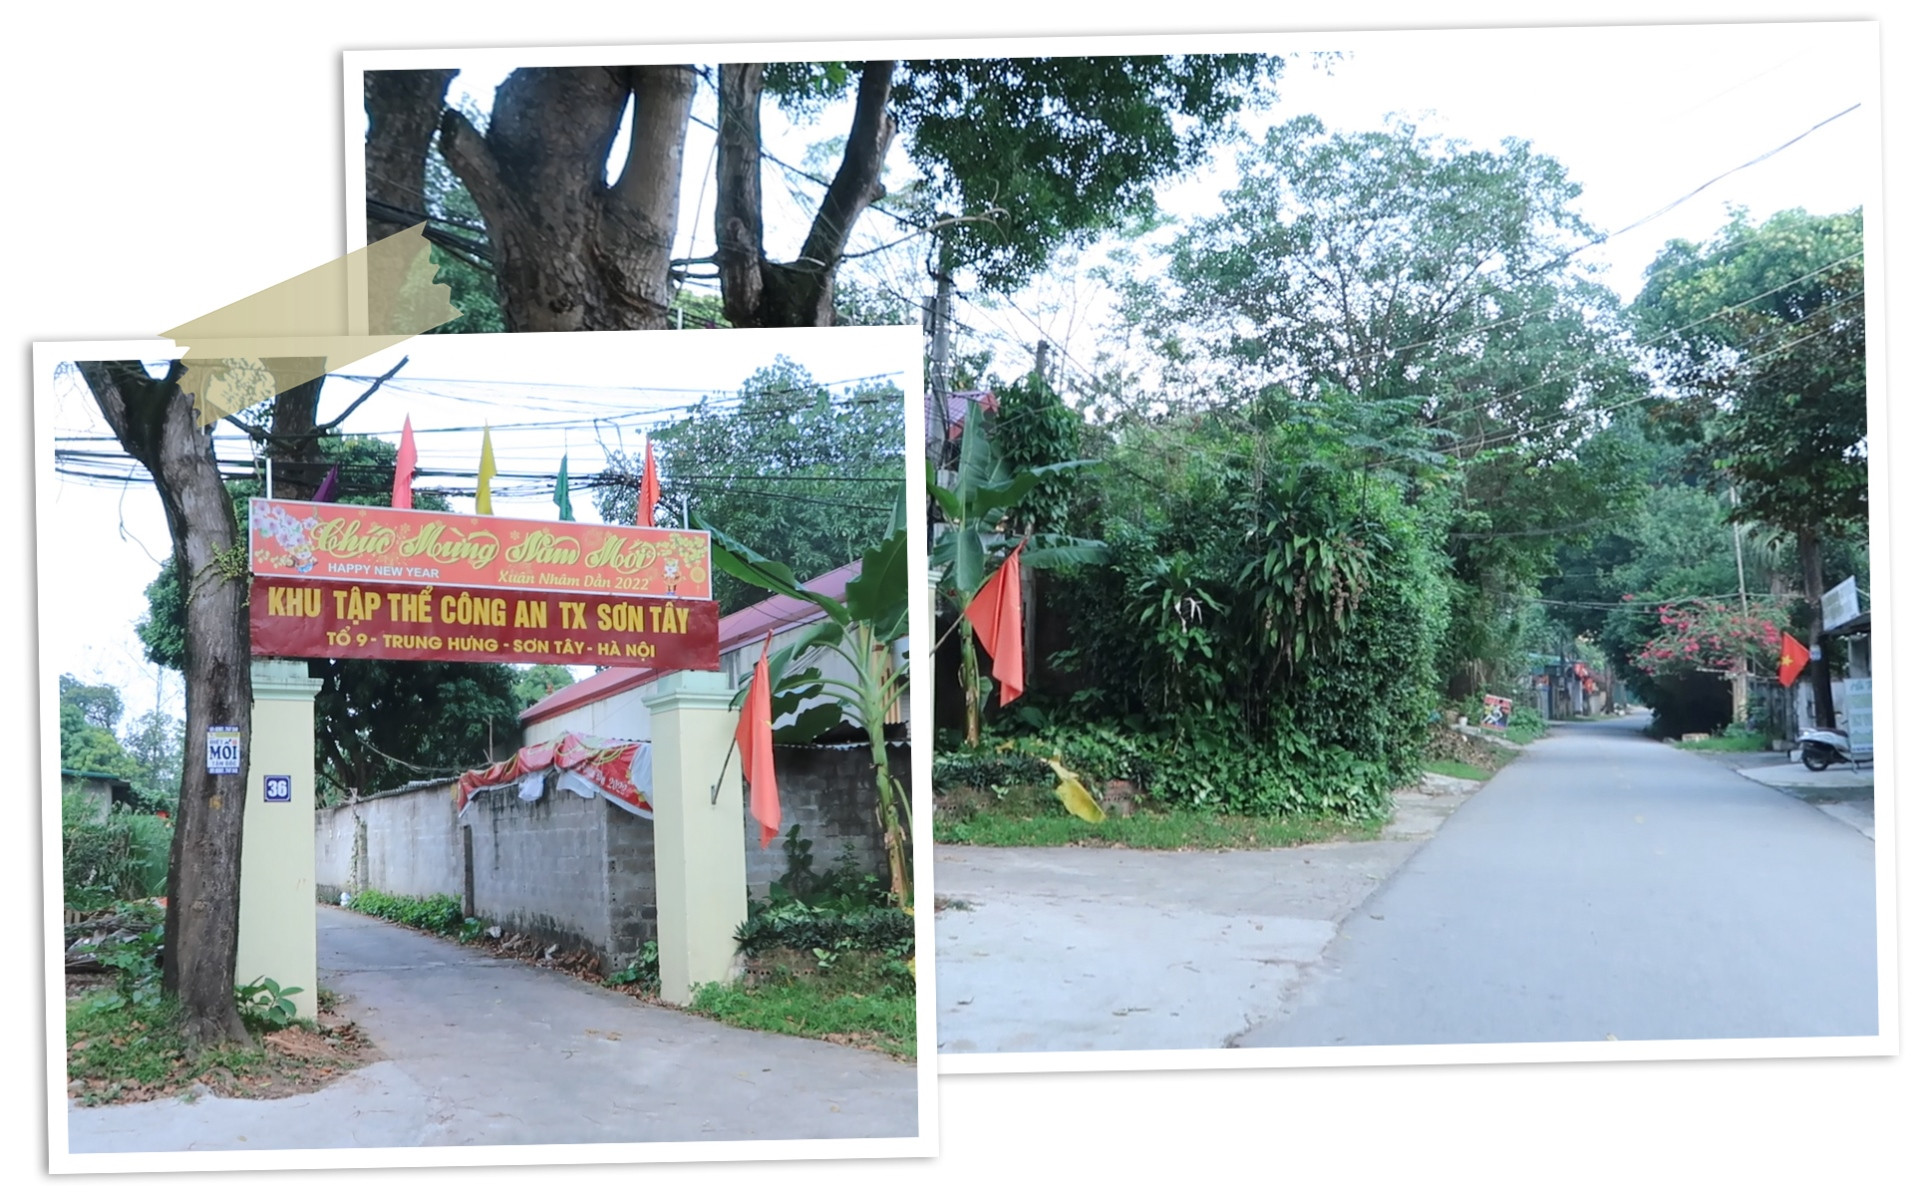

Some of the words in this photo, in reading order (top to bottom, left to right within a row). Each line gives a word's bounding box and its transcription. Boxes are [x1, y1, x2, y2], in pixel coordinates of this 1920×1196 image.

[311, 517, 396, 559] Chúc
[400, 522, 500, 570] Mừng
[505, 530, 581, 565] Năm
[586, 534, 657, 575] Mới
[328, 563, 371, 575] HAPPY
[374, 566, 402, 577] NEW
[406, 568, 440, 579] YEAR
[498, 570, 535, 585] Xuân
[538, 573, 580, 588] Nhâm
[583, 574, 611, 589] Dần
[614, 576, 649, 591] 2022
[268, 586, 322, 618] KHU
[332, 586, 381, 625] TẬP
[387, 585, 433, 623] THỂ
[440, 591, 506, 627] CÔNG
[514, 600, 547, 629] AN
[559, 602, 587, 630] TX
[596, 602, 644, 633] SƠN
[649, 601, 690, 635] TÂY
[326, 626, 351, 646] TỔ
[356, 633, 367, 647] 9
[383, 634, 442, 650] TRUNG
[448, 635, 499, 652] HƯNG
[513, 639, 549, 653] SƠN
[553, 638, 584, 655] TÂY
[598, 640, 621, 656] HÀ
[626, 643, 656, 662] NỘI
[209, 738, 237, 760] MỐI
[267, 780, 288, 797] 36
